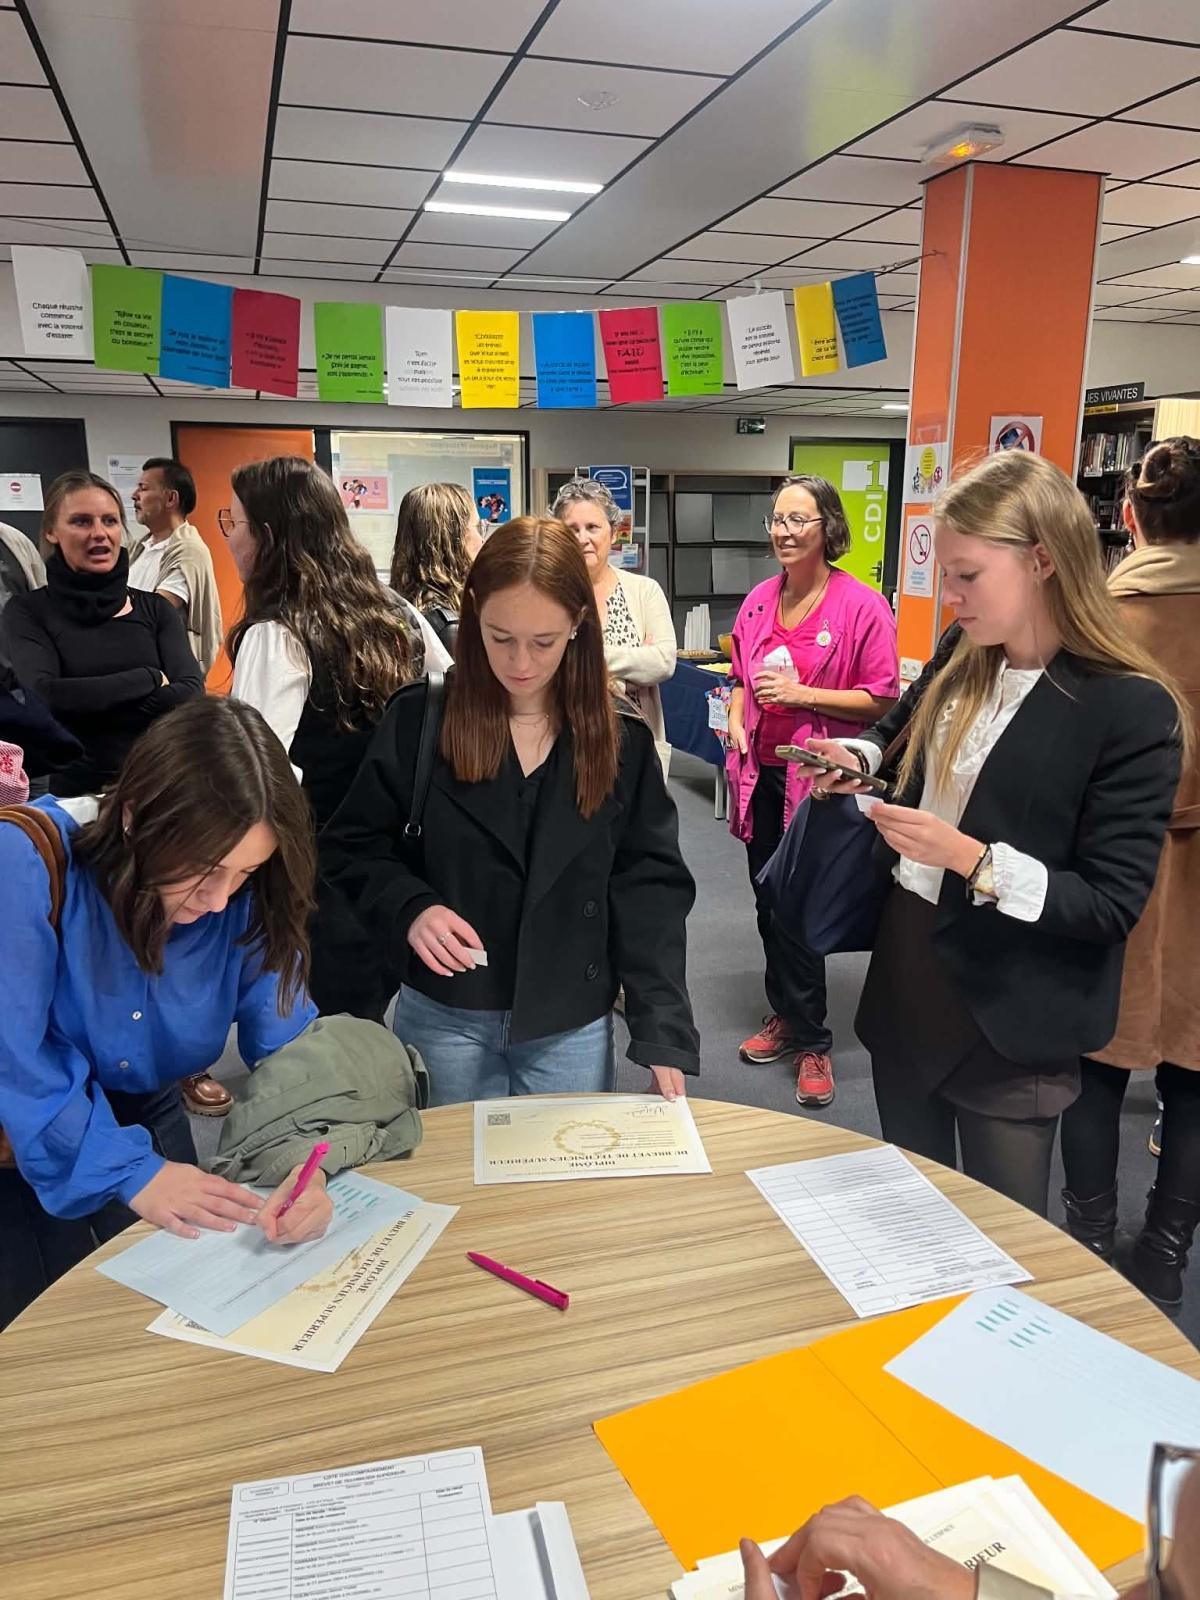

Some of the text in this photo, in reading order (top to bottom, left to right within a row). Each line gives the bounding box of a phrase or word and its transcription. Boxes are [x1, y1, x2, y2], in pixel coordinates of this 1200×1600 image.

[1100, 388, 1138, 402] VIVANTES
[866, 460, 884, 492] 1
[864, 494, 882, 542] CDI
[402, 1210, 414, 1220] DU
[380, 1220, 406, 1248] BREVET
[370, 1246, 384, 1257] DE
[332, 1258, 376, 1303] TECHNICIEN
[356, 1259, 390, 1294] DIPLÔME
[291, 1304, 336, 1352] SUPÉRIEUR
[964, 1542, 1006, 1570] RIEUR
